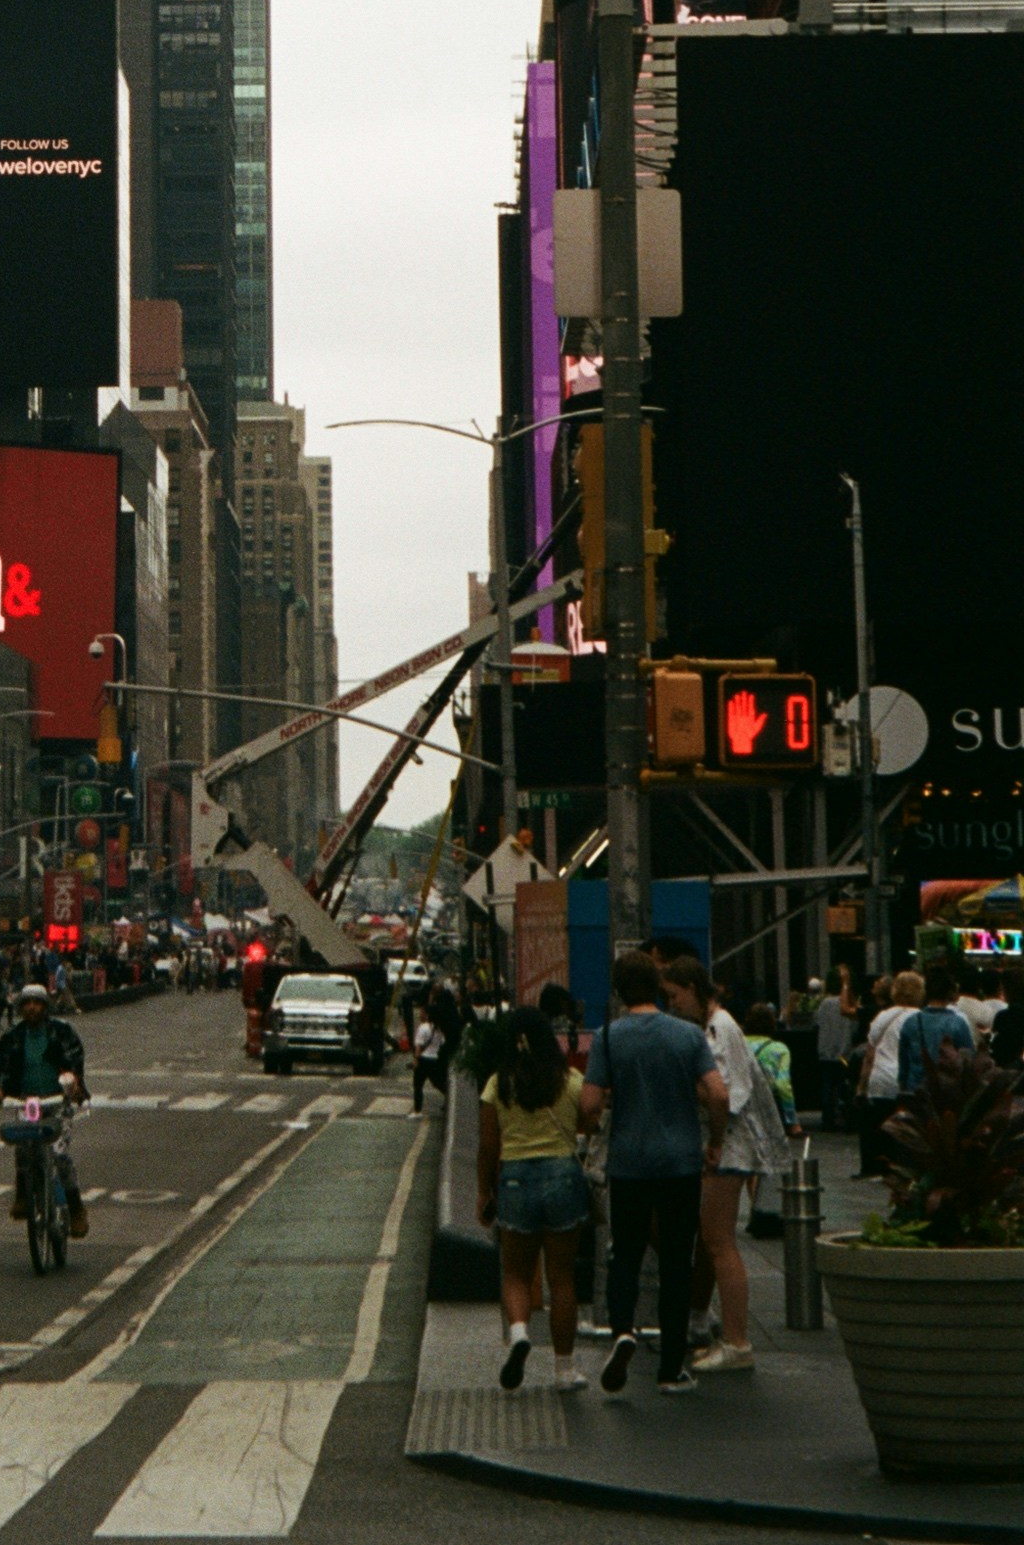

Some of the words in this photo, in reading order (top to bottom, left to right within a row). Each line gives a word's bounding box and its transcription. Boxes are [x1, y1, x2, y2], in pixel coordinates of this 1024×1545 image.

[0, 139, 50, 151] FOLLOW
[52, 138, 69, 150] US
[279, 712, 322, 740] NORTH
[952, 707, 1024, 752] su
